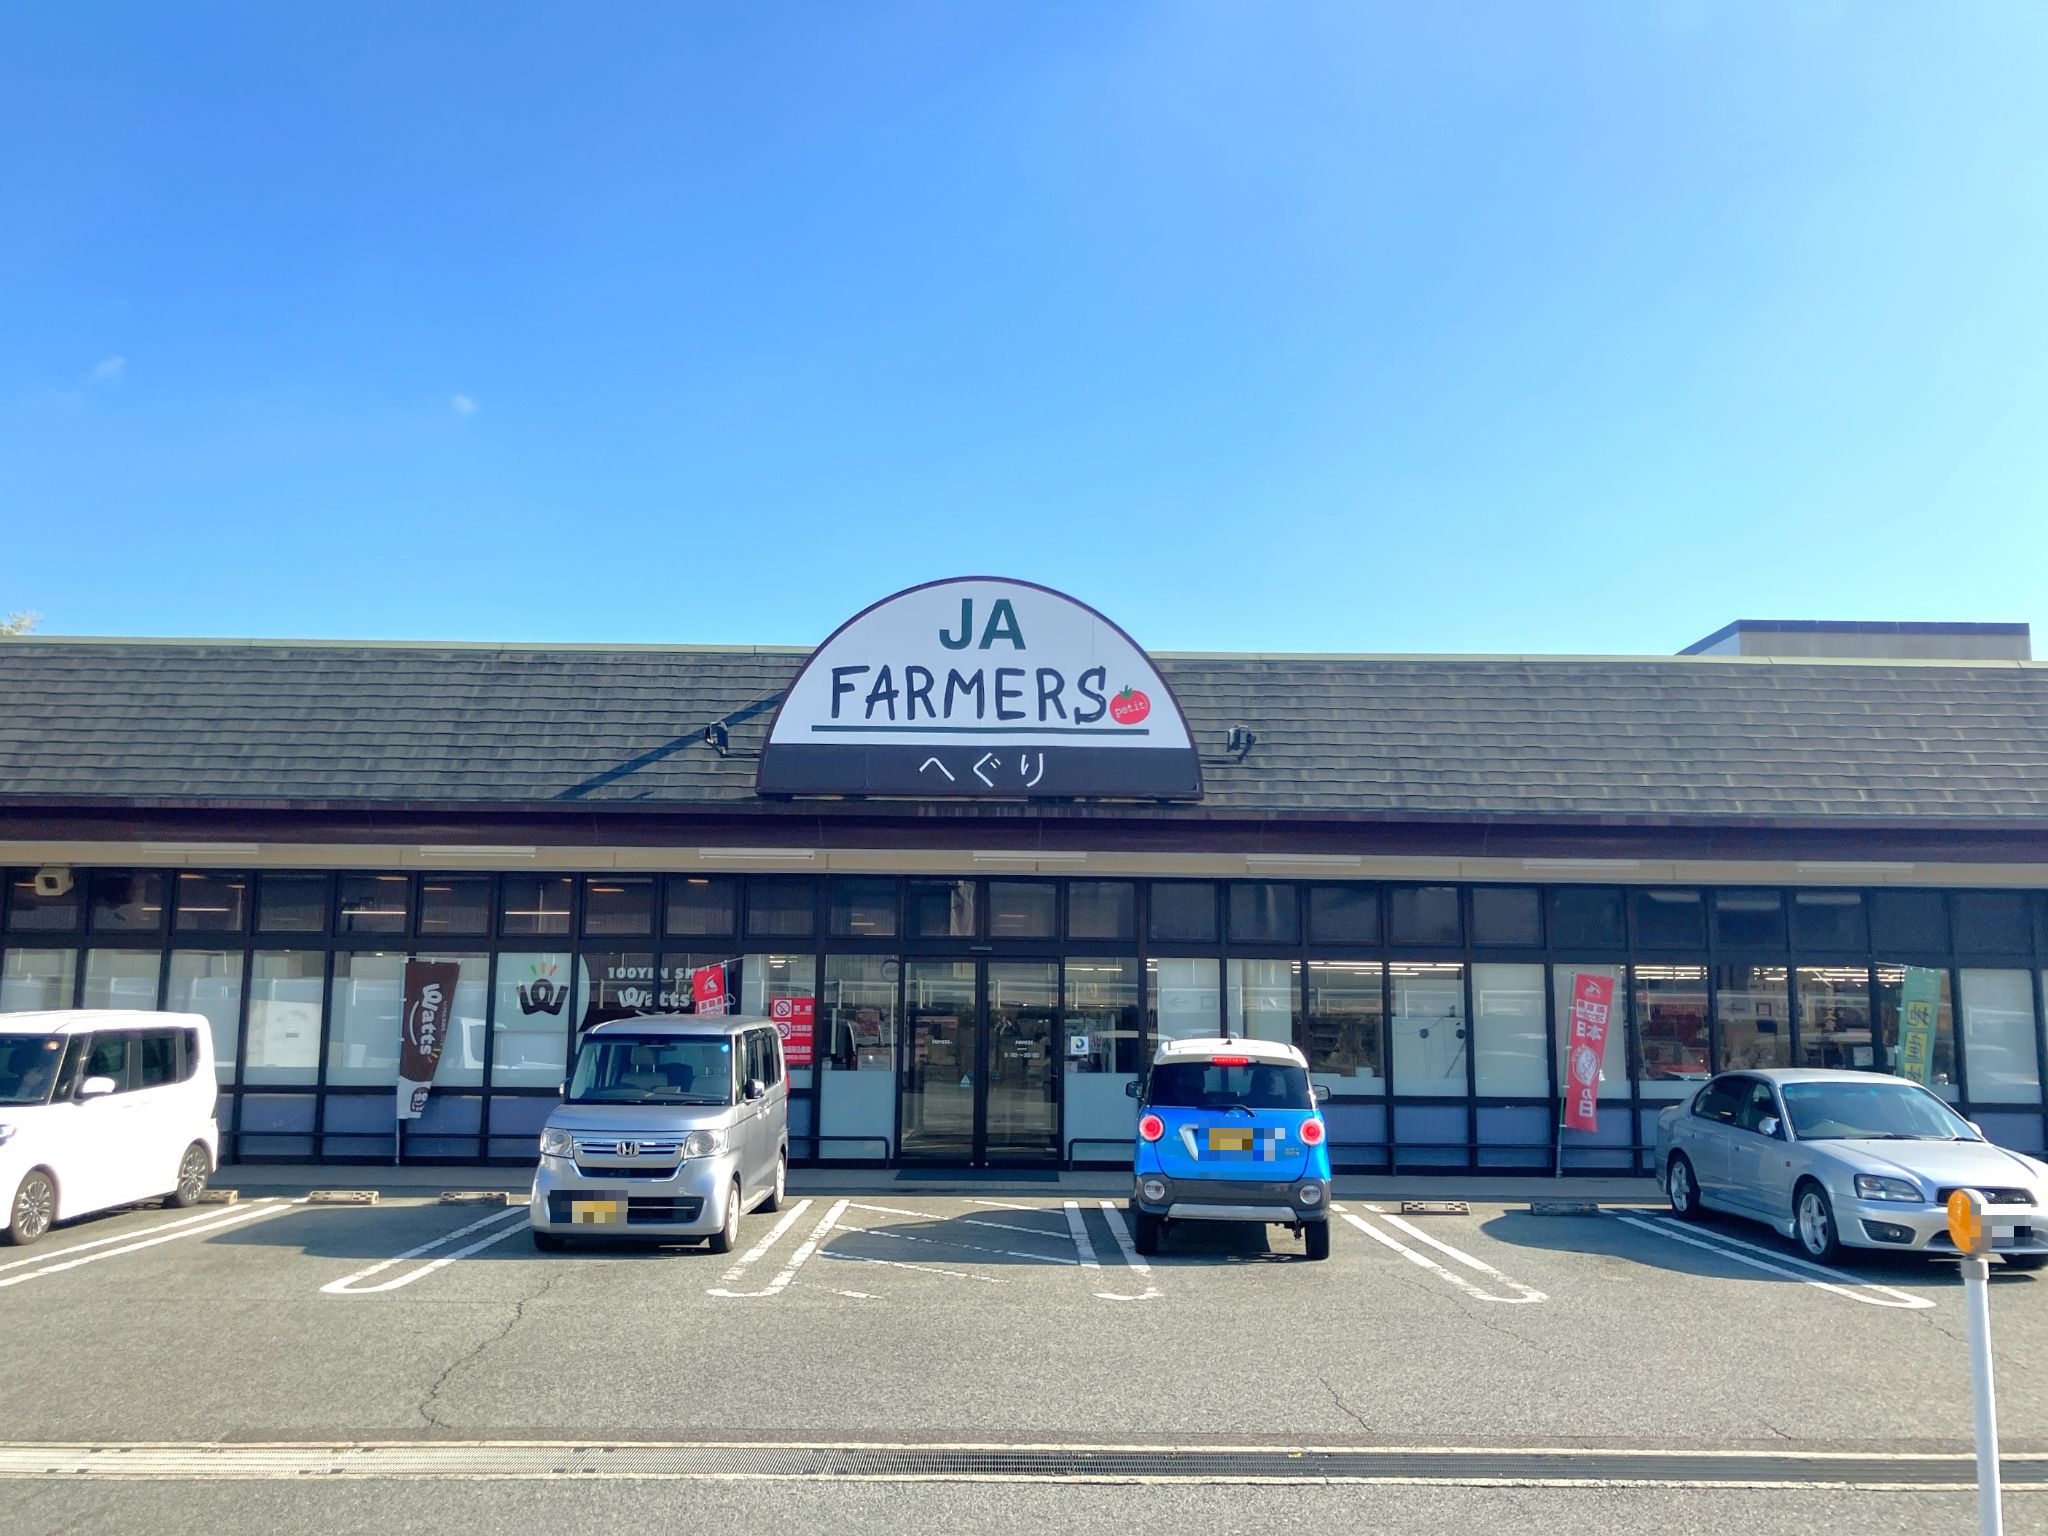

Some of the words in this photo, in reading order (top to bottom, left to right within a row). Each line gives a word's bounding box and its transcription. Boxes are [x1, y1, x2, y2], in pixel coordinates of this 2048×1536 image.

[938, 598, 1026, 650] JA
[831, 664, 1107, 725] FARMERS
[1115, 701, 1145, 718] petit
[919, 752, 1044, 788] へぐり
[420, 983, 443, 1055] Watts
[618, 987, 690, 1008] Watts
